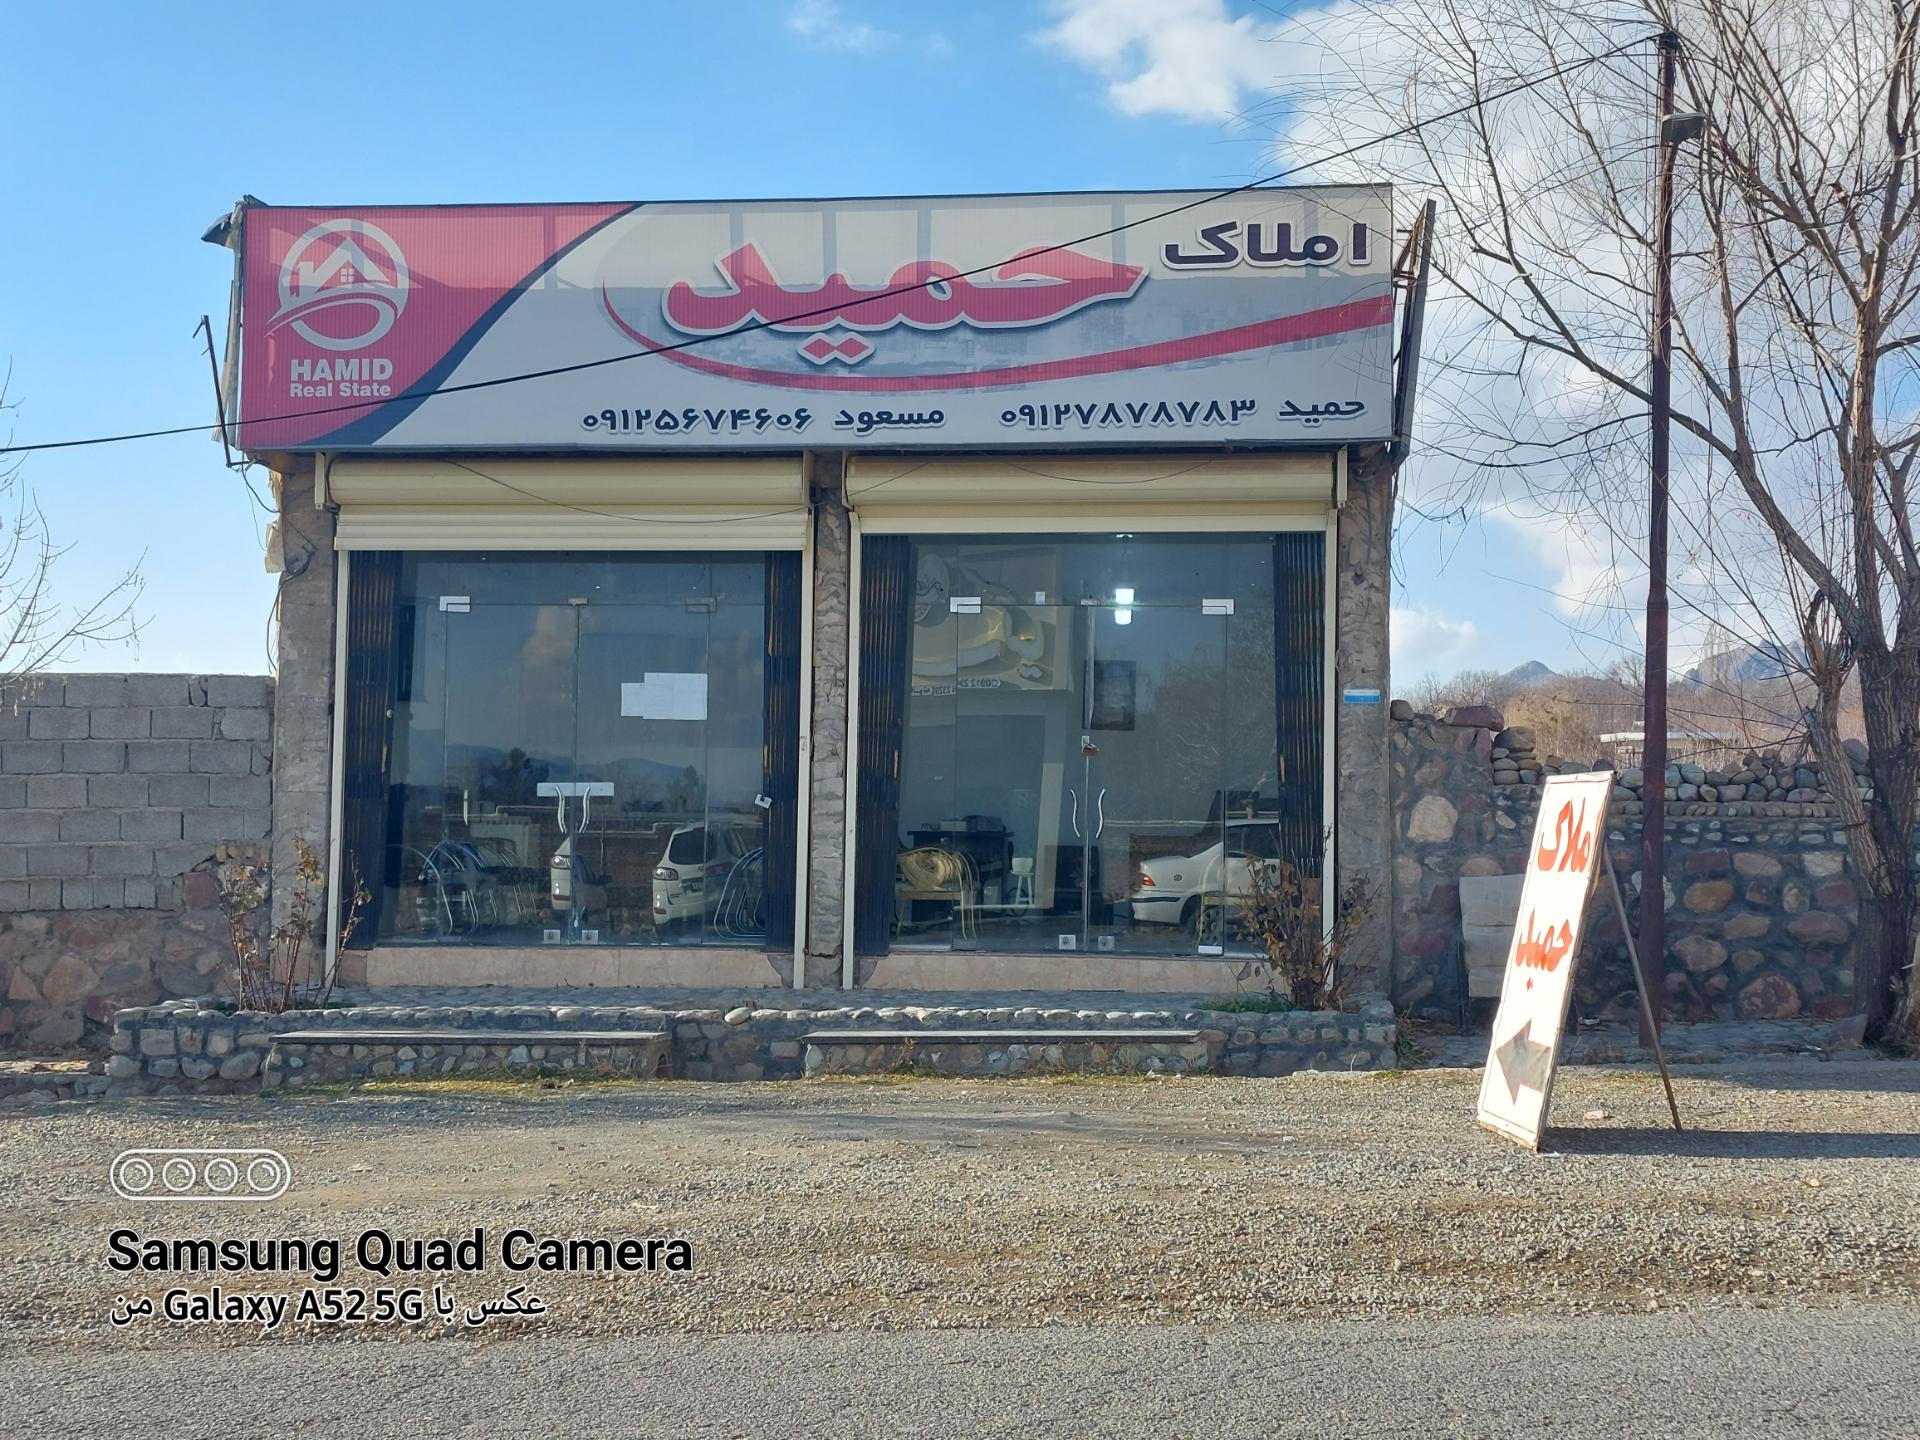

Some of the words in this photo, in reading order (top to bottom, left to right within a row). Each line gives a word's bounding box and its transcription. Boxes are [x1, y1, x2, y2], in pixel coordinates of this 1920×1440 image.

[1163, 219, 1369, 266] املاک
[663, 241, 1149, 364] حمید
[290, 358, 393, 381] HAMID
[290, 383, 333, 397] Real
[339, 382, 391, 397] State
[582, 407, 814, 431] ۰۹۱۲۵۶۷۴۶۰۶
[834, 407, 946, 433] مسعود
[1001, 399, 1256, 426] ۰۹۱۲۷۸۷۸۷۸۳
[1278, 399, 1366, 424] حمید
